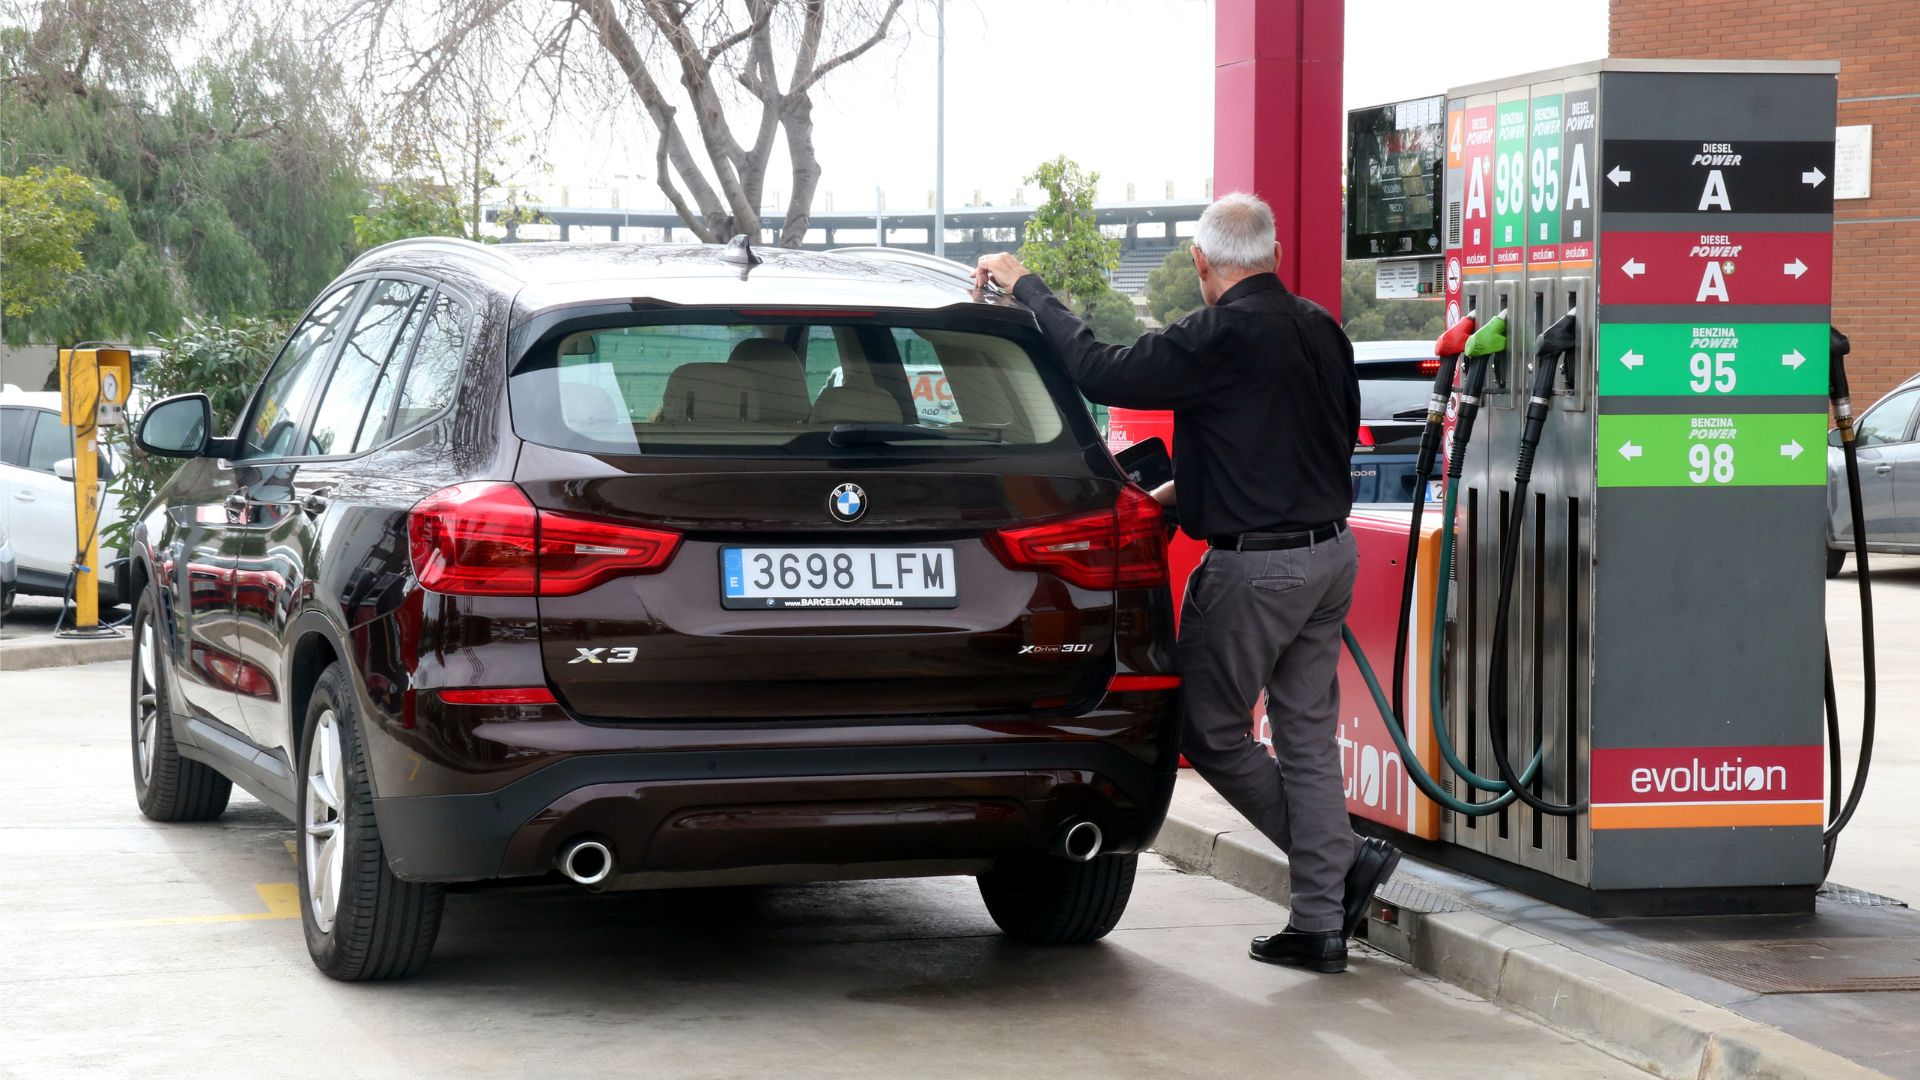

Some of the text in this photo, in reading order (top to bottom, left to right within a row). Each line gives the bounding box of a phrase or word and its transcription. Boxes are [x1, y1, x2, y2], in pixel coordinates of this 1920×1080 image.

[1534, 106, 1559, 120] BENZINA
[1572, 100, 1590, 116] DIESEL
[1471, 117, 1488, 130] DIESEL
[1500, 112, 1524, 125] BENZINA
[1565, 114, 1595, 132] POWER
[1499, 124, 1525, 141] POWER
[1533, 119, 1560, 136] POWER
[1450, 117, 1462, 160] 4
[1702, 143, 1733, 153] DIESEL
[1691, 154, 1742, 166] POWER
[1496, 151, 1524, 216] 98
[1531, 146, 1559, 213] 95
[1565, 143, 1590, 211] A
[1698, 169, 1732, 211] A
[1700, 235, 1731, 245] DIESEL
[1466, 252, 1486, 264] evolution
[1498, 250, 1518, 262] evolution
[1533, 247, 1554, 260] evolution
[1566, 245, 1588, 258] evolution
[1692, 327, 1735, 337] BENZINA
[1689, 338, 1739, 349] POWER
[1689, 352, 1737, 393] 95
[1691, 417, 1733, 428] BENZINA
[1688, 428, 1737, 440] POWER
[1688, 443, 1735, 484] 98
[753, 552, 945, 590] 3698 LFM
[730, 576, 738, 588] E
[567, 647, 639, 664] X3
[1631, 757, 1787, 793] evolution
